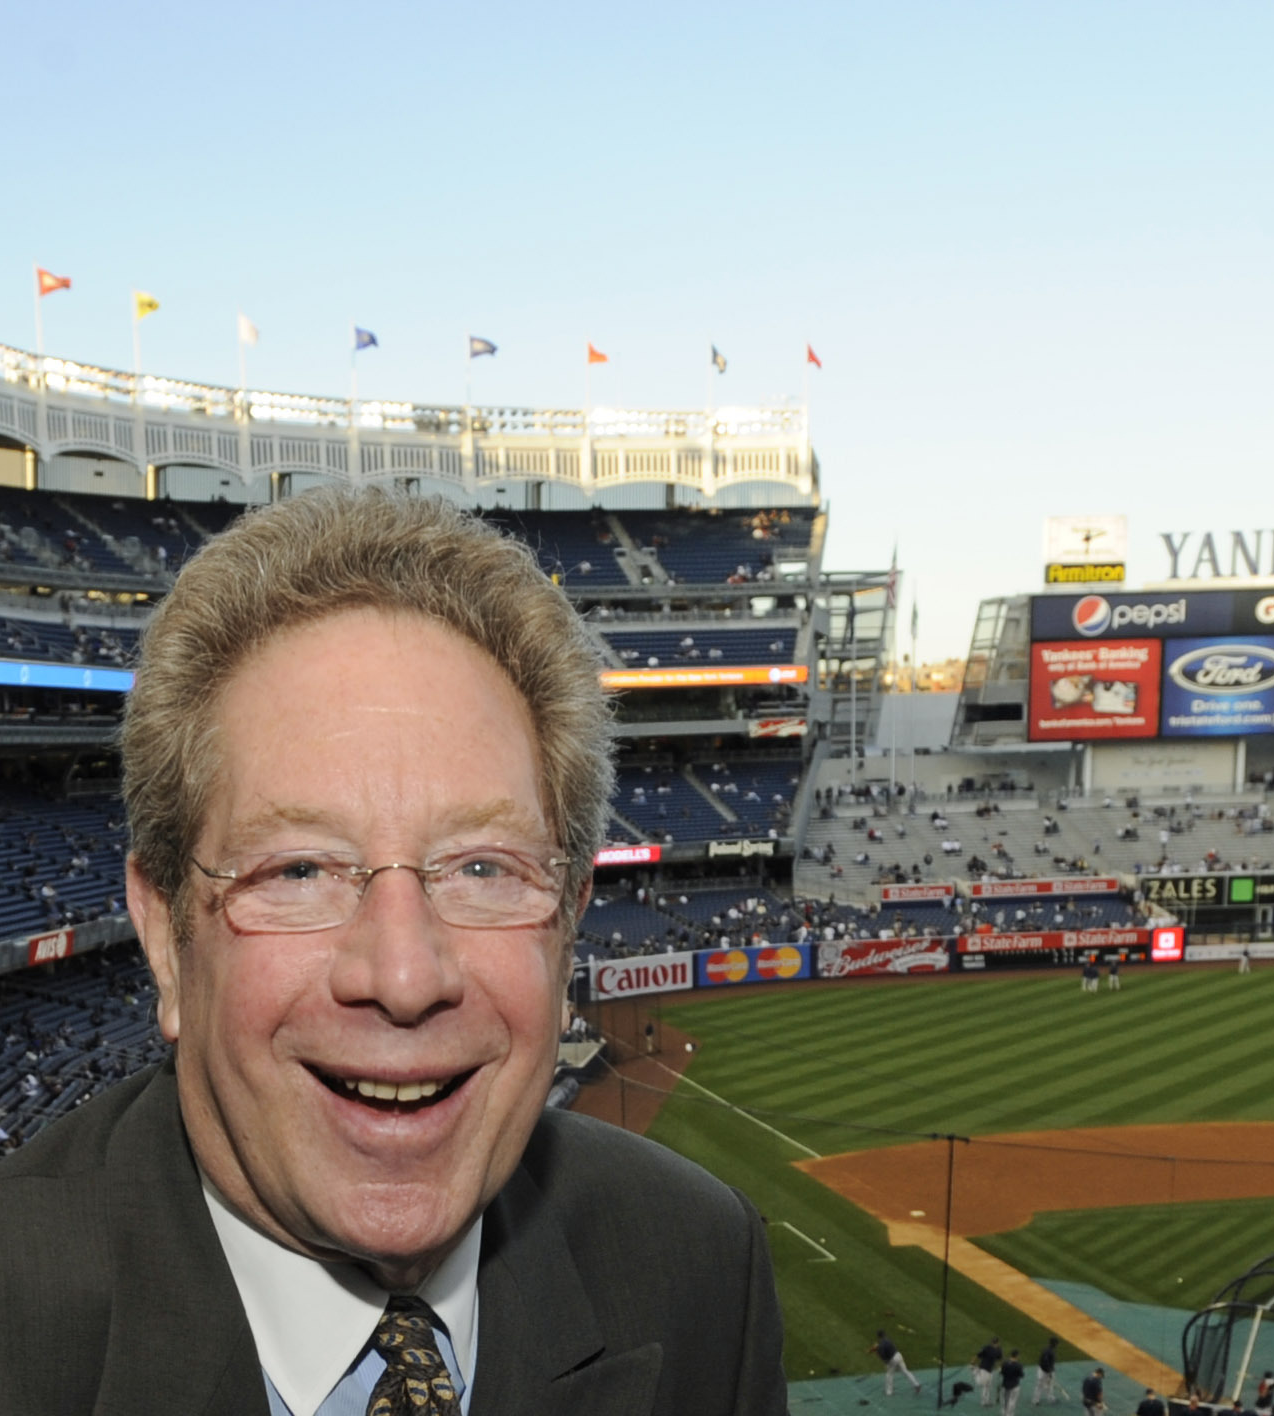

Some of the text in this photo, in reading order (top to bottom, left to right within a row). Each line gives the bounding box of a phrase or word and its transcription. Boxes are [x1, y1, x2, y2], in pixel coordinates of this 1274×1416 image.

[1047, 564, 1125, 584] Armitron
[1111, 599, 1186, 629] pepsi
[1195, 655, 1265, 687] Ford
[1148, 878, 1217, 899] ZALES
[830, 940, 932, 976] Budweiser
[596, 961, 688, 994] Canon
